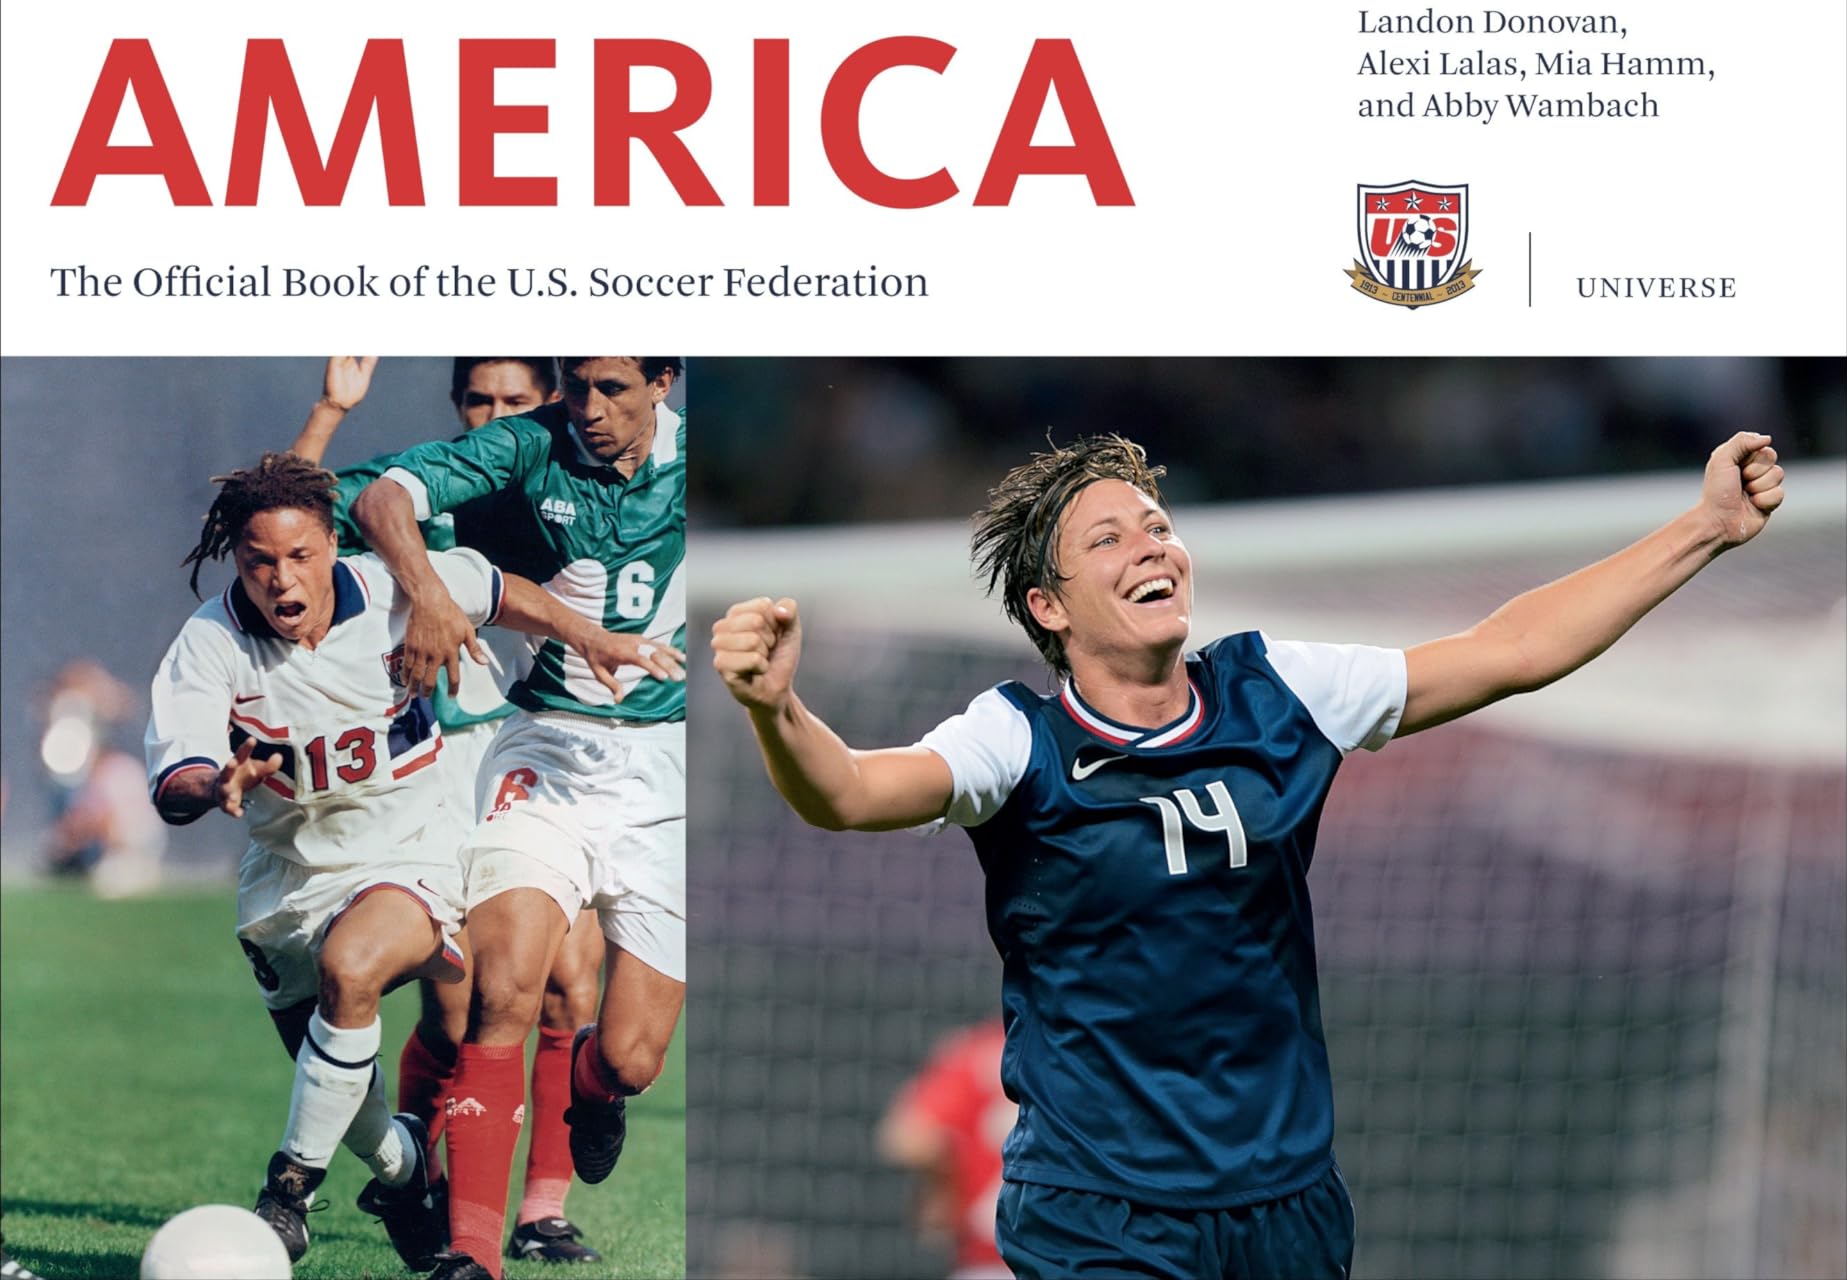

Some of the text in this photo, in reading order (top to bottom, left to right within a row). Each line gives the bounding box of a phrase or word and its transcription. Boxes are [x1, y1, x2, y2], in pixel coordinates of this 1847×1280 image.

[1360, 8, 1627, 39] Landon Donovan,
[1358, 50, 1715, 81] Alexi Lalas, Mia Hamm,
[50, 36, 1135, 209] AMERICA
[1359, 92, 1659, 125] and Abby Wambach
[1370, 217, 1458, 257] US
[51, 264, 928, 297] The Official Book of the U.S. Soccer Federation
[1360, 279, 1467, 303] 1913 CENTENNIAL 2013
[1577, 277, 1736, 298] UNIVERSE
[540, 498, 577, 516] ABA
[616, 560, 655, 619] 6
[305, 726, 377, 792] 13
[1139, 780, 1247, 875] 14
